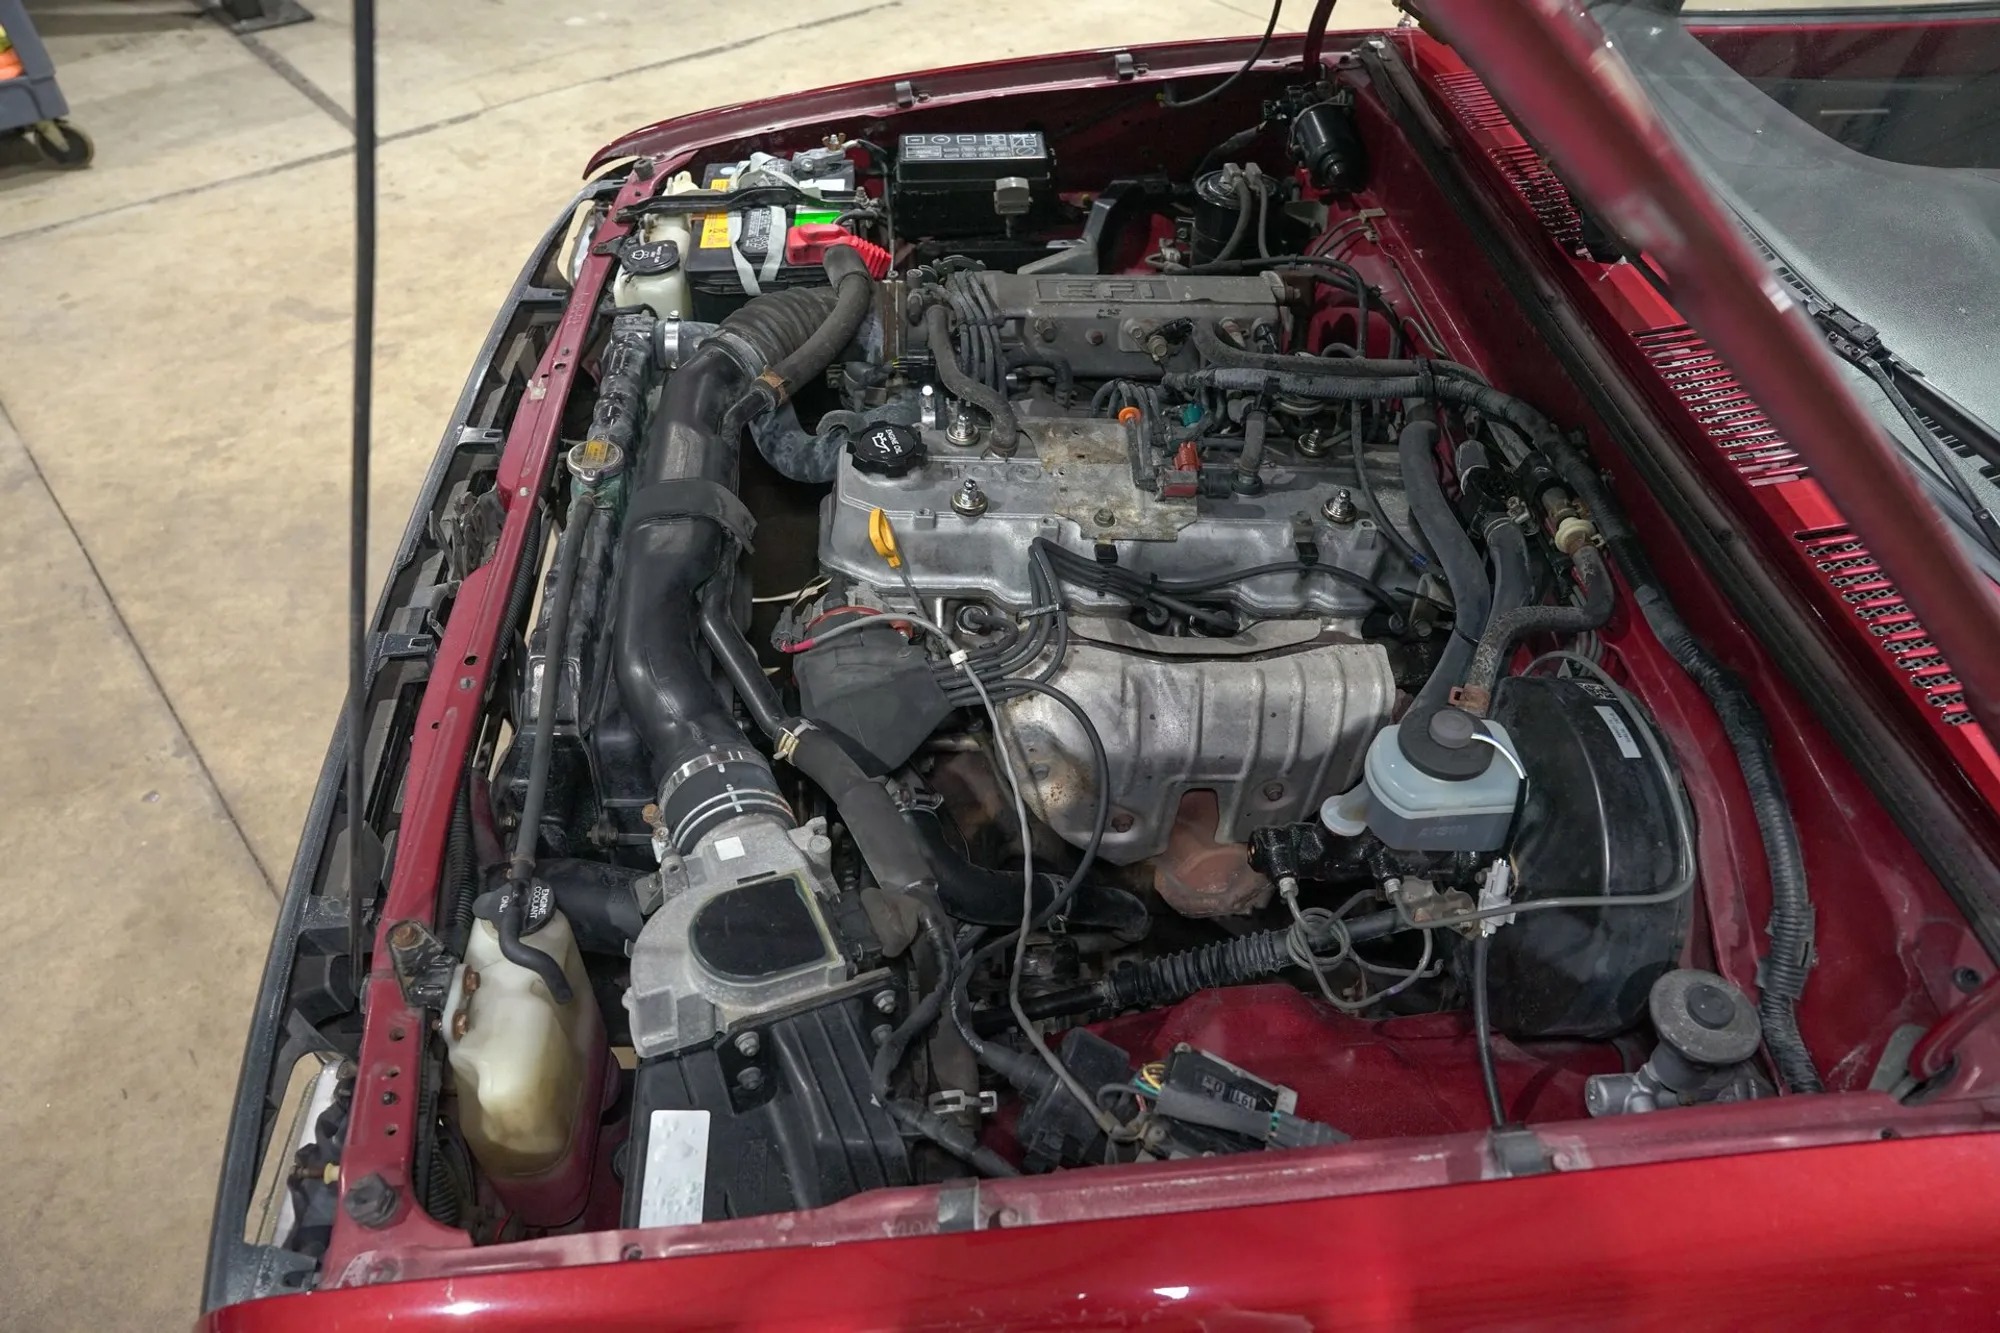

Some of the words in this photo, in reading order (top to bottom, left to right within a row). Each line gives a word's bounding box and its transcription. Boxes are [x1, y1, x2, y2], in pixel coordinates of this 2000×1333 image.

[1057, 281, 1155, 299] EFI
[885, 428, 900, 446] ENGINE
[943, 463, 1043, 483] TOYO
[529, 885, 543, 919] COOLANT
[538, 888, 550, 916] ENGINE
